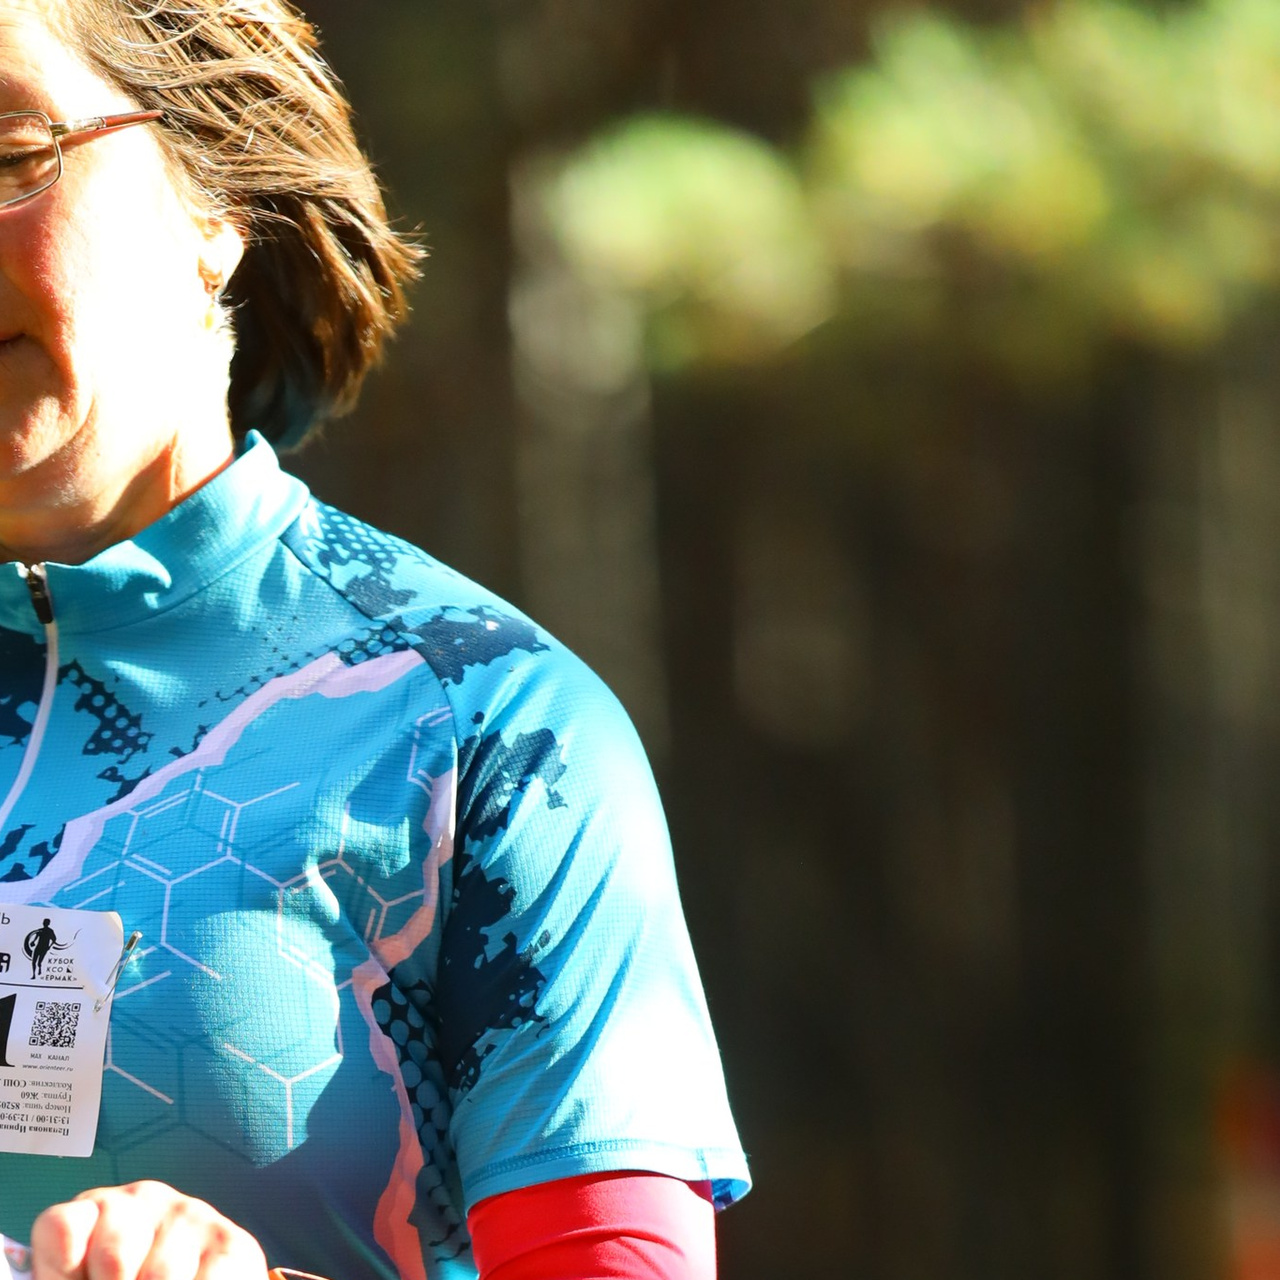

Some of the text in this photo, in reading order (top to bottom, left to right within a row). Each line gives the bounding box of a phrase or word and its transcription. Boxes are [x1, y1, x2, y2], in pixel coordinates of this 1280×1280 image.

[22, 1063, 74, 1072] www.orienteer.ru
[3, 1079, 27, 1089] СОШ
[20, 1091, 39, 1100] Ж60
[36, 1115, 70, 1125] 13:31:00
